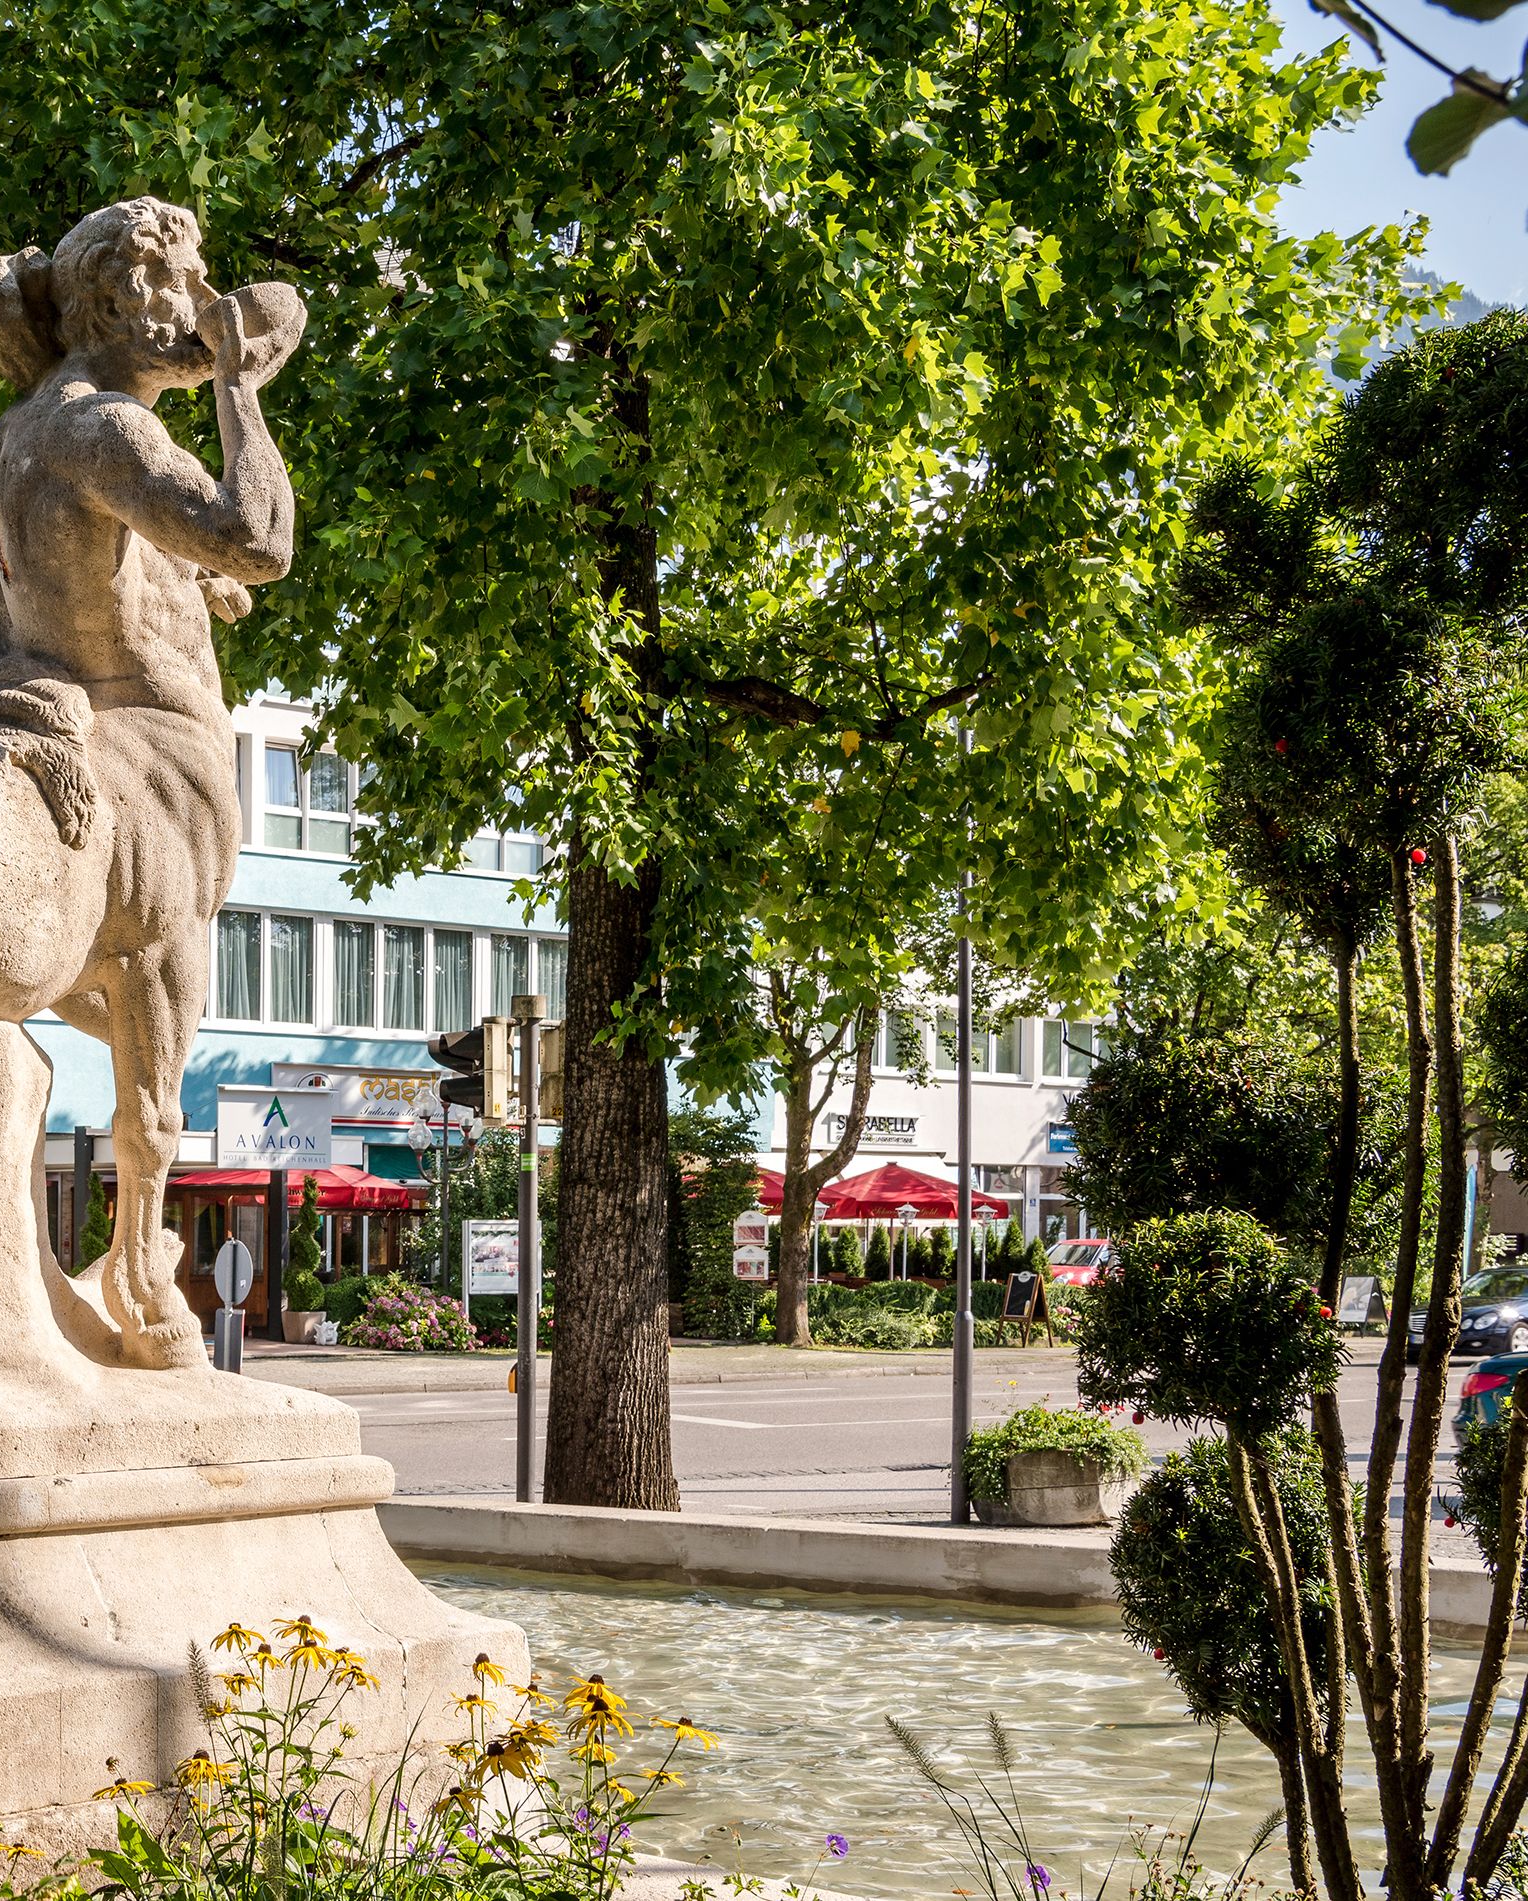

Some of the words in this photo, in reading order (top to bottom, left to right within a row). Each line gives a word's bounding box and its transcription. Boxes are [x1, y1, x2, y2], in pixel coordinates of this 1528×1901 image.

[552, 1107, 563, 1116] 22
[236, 1134, 316, 1150] AVALON
[223, 1154, 248, 1162] HOTEL
